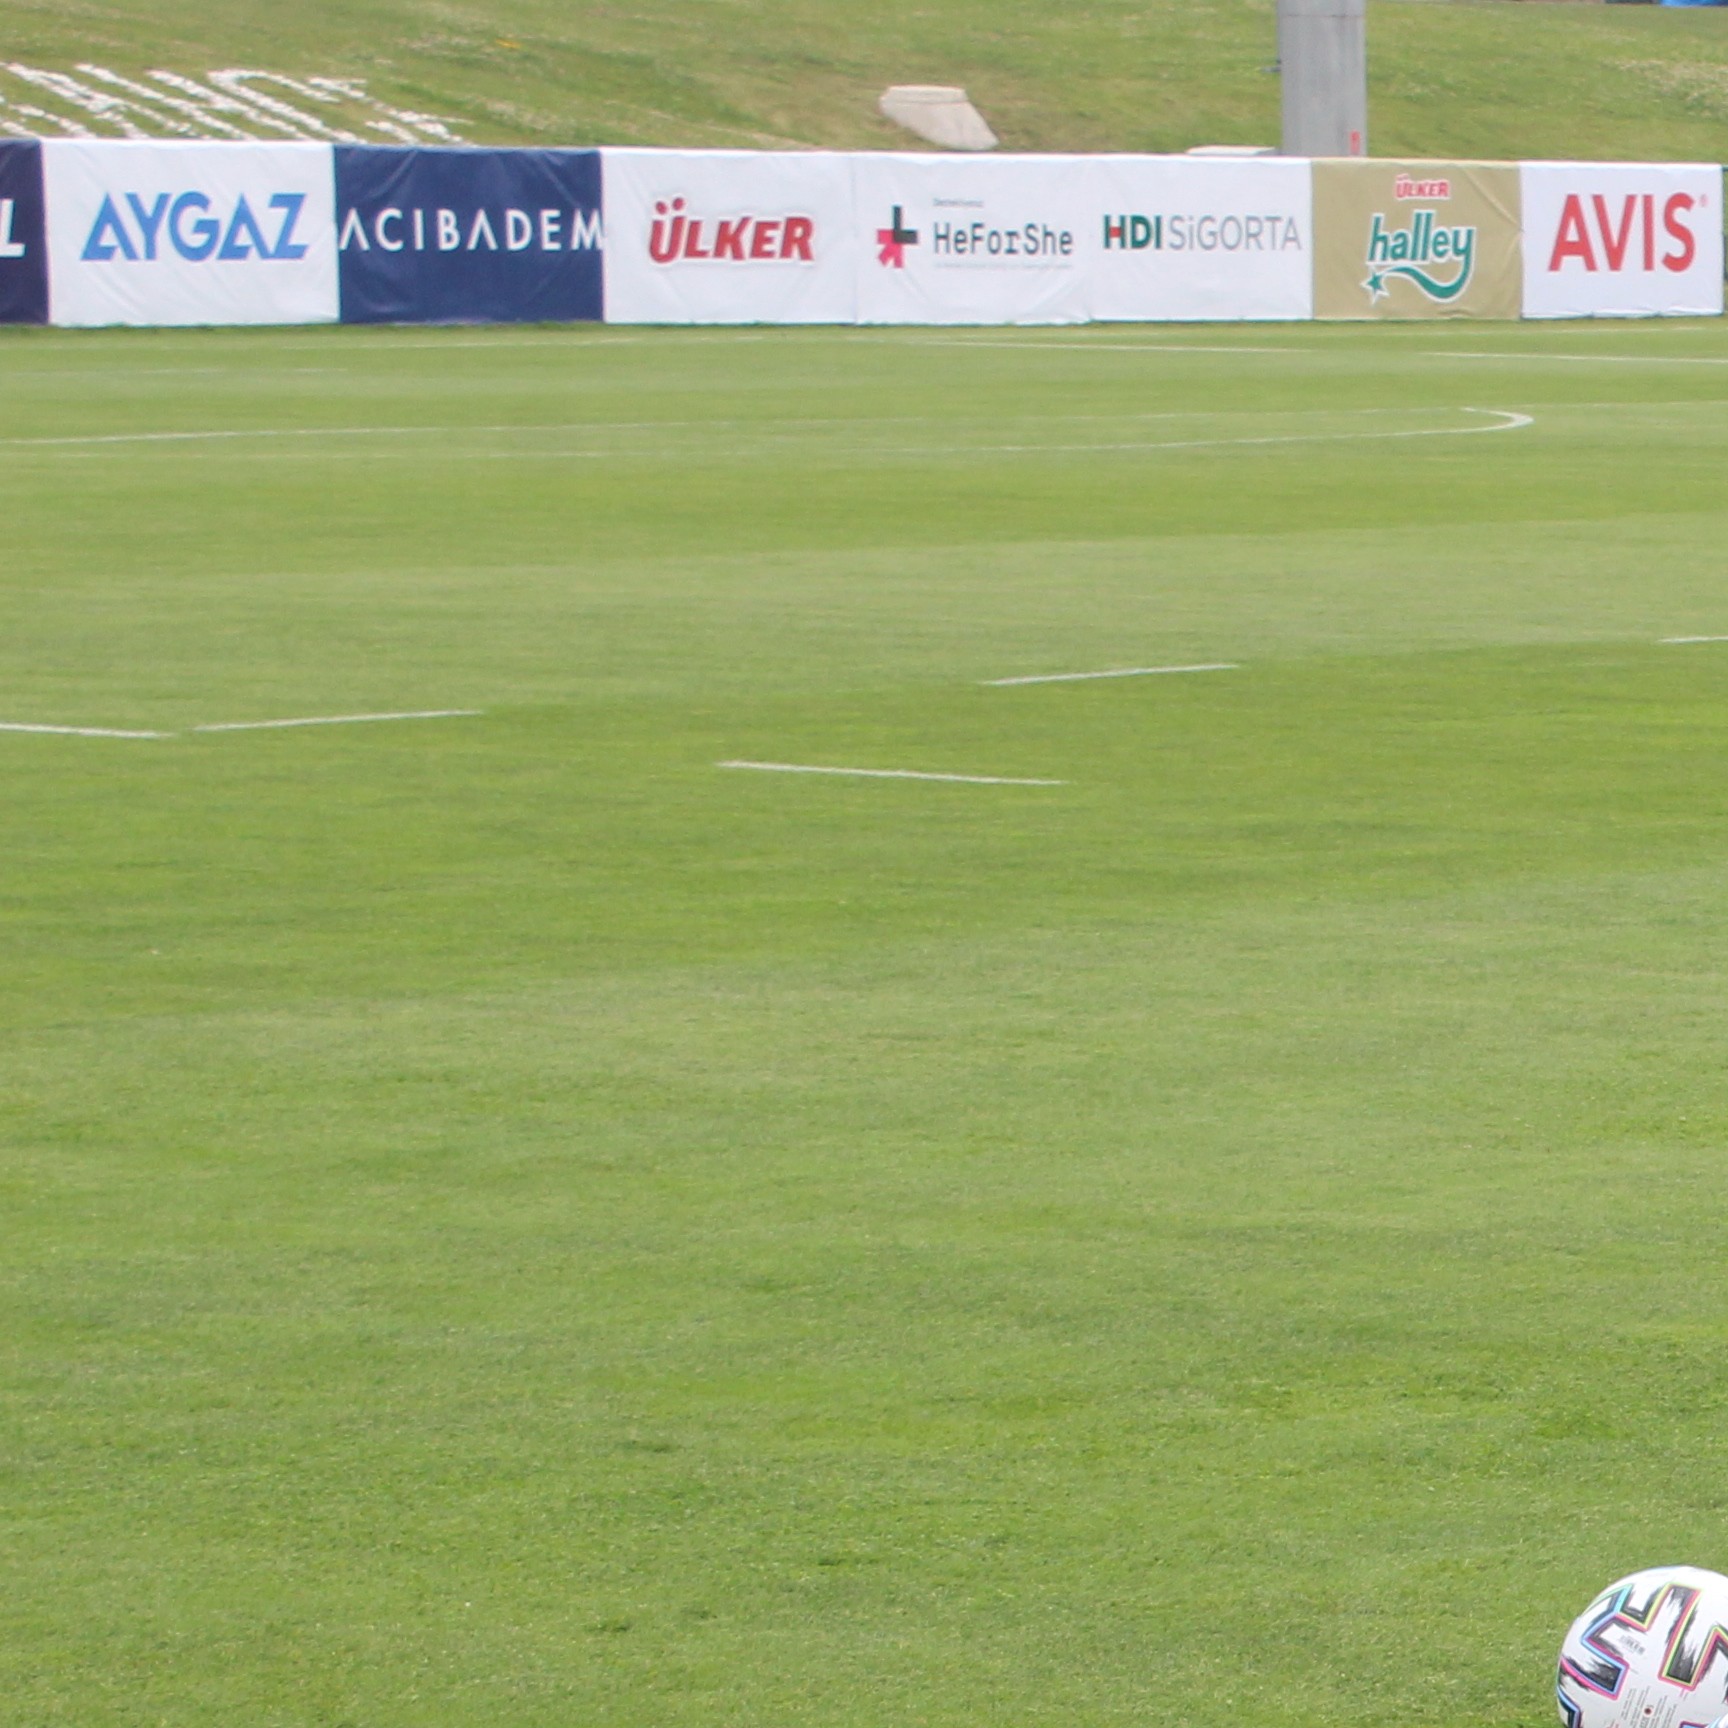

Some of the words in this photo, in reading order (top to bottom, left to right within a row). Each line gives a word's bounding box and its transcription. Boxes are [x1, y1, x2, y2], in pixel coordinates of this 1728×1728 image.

[80, 191, 309, 262] AYGAZ
[339, 208, 605, 251] ACIBADEM
[649, 197, 814, 264] ÜLKER
[933, 222, 1074, 255] HeForShe
[1103, 215, 1162, 250] HDI
[1366, 209, 1475, 300] halley
[1547, 192, 1697, 272] AVIS
